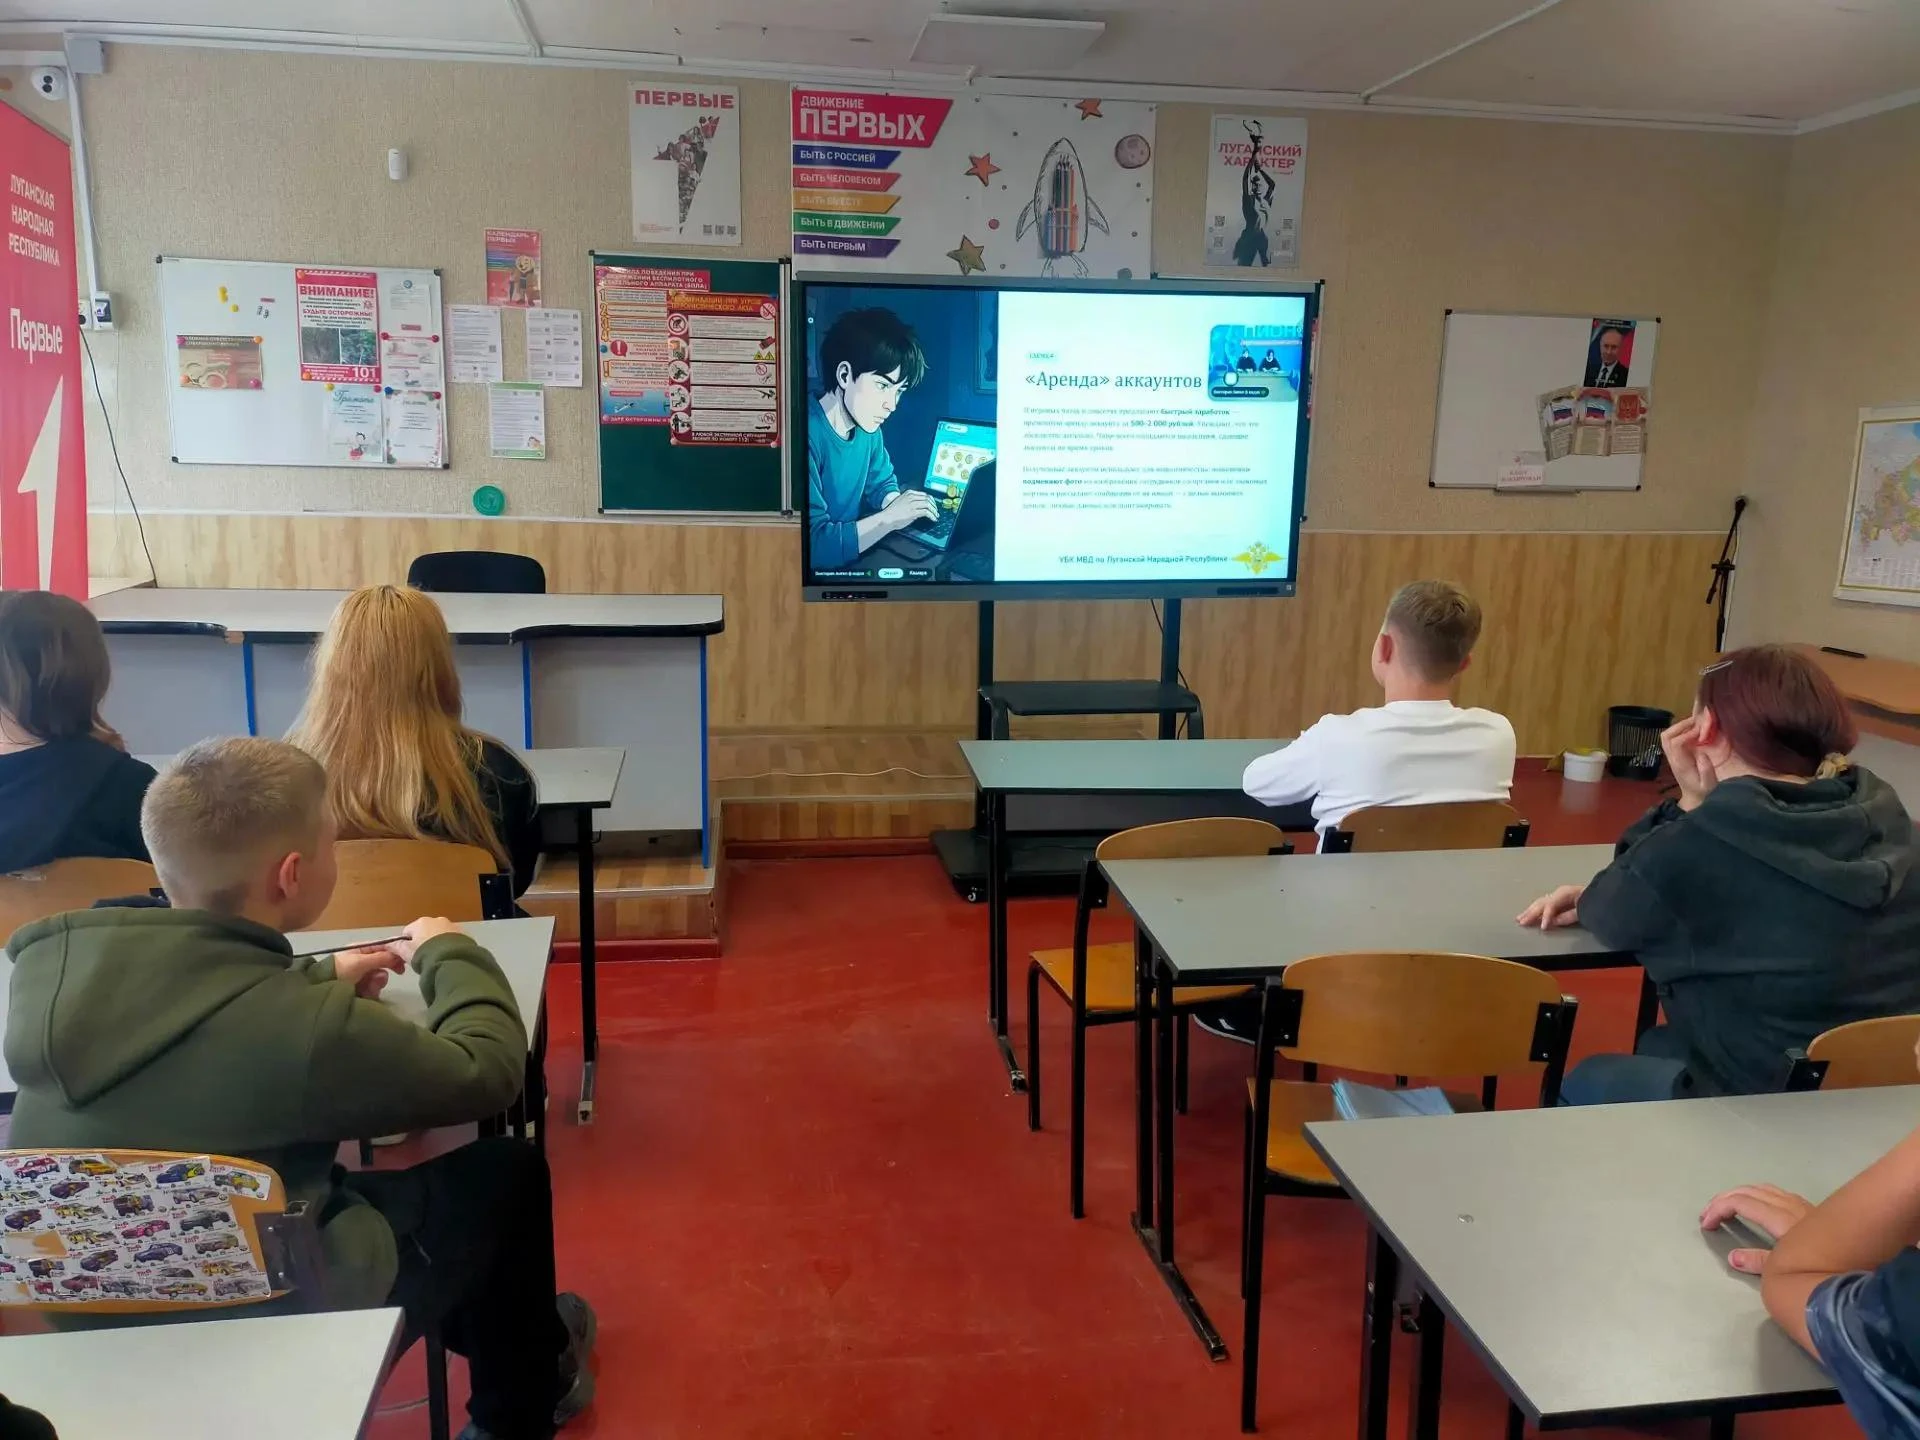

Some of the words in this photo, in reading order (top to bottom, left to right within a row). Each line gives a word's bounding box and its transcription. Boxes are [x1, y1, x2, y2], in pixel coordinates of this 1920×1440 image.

[635, 90, 734, 109] ПЕРВЫЕ
[801, 95, 864, 110] ДВИЖЕНИЕ
[800, 108, 925, 141] ПЕРВЫХ
[800, 151, 825, 160] БЫТЬ
[827, 152, 833, 160] С
[834, 151, 876, 164] РОССИЕЙ
[1224, 155, 1296, 168] ХАРКТЕР
[800, 173, 825, 183] БЫТЬ
[826, 174, 881, 186] ЧЕЛОВЕКОМ
[10, 174, 55, 211] ЛУГАНСКАЯ
[11, 204, 54, 238] НАРОДНАЯ
[801, 218, 825, 227] БЫТЬ
[827, 219, 833, 228] В
[834, 219, 885, 230] ДВИЖЕНИИ
[8, 233, 60, 266] РЕСПУБЛИКА
[801, 240, 826, 249] БЫТЬ
[827, 241, 866, 252] ПЕРВЫМ
[652, 275, 703, 283] БЕСПИЛОТНОГО
[300, 285, 374, 298] ВНИМАНИЕ!
[10, 307, 63, 364] Первые
[352, 367, 376, 378] 101
[1025, 371, 1109, 390] «Аренда»
[1114, 375, 1202, 391] аккаунтов
[1195, 409, 1230, 417] заработок
[1064, 478, 1082, 486] фото
[1059, 556, 1074, 564] УБК
[1076, 556, 1094, 565] МВД
[1107, 555, 1145, 565] Луганской
[1147, 555, 1184, 564] Народной
[1185, 555, 1228, 565] Республике
